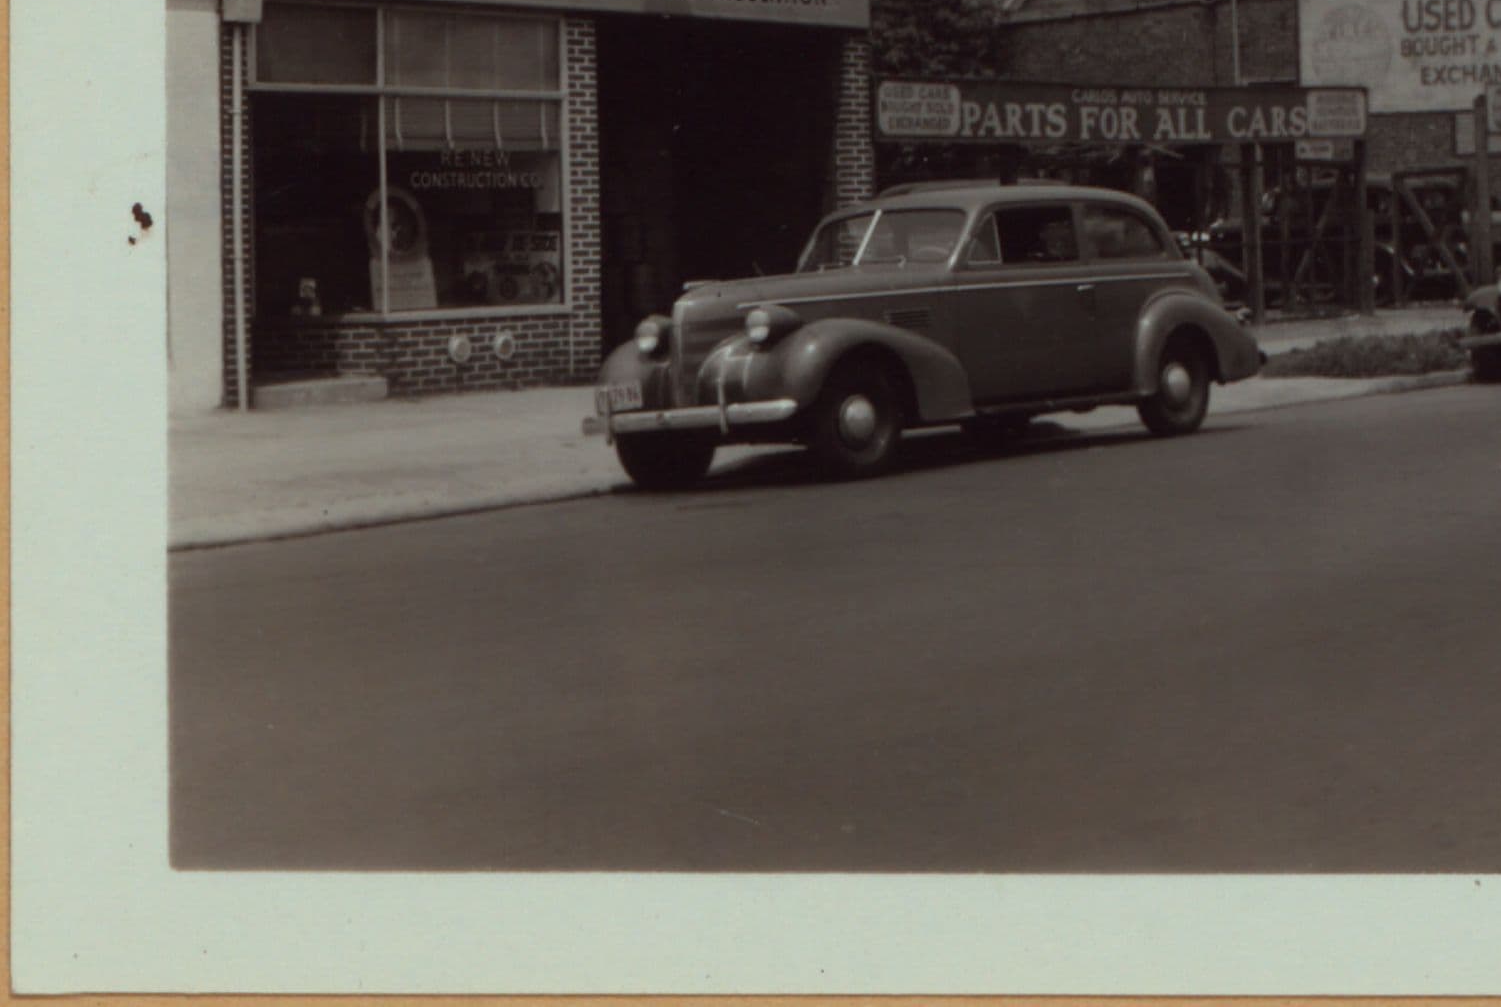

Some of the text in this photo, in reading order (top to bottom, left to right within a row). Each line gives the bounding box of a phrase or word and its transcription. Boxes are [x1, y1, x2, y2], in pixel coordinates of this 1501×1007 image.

[1400, 33, 1480, 59] BOUGHT
[960, 101, 1068, 139] PARTS
[1079, 105, 1142, 141] FOR
[1153, 106, 1212, 140] ALL
[1226, 104, 1307, 138] CARS
[409, 171, 518, 190] CONSTRUCTION
